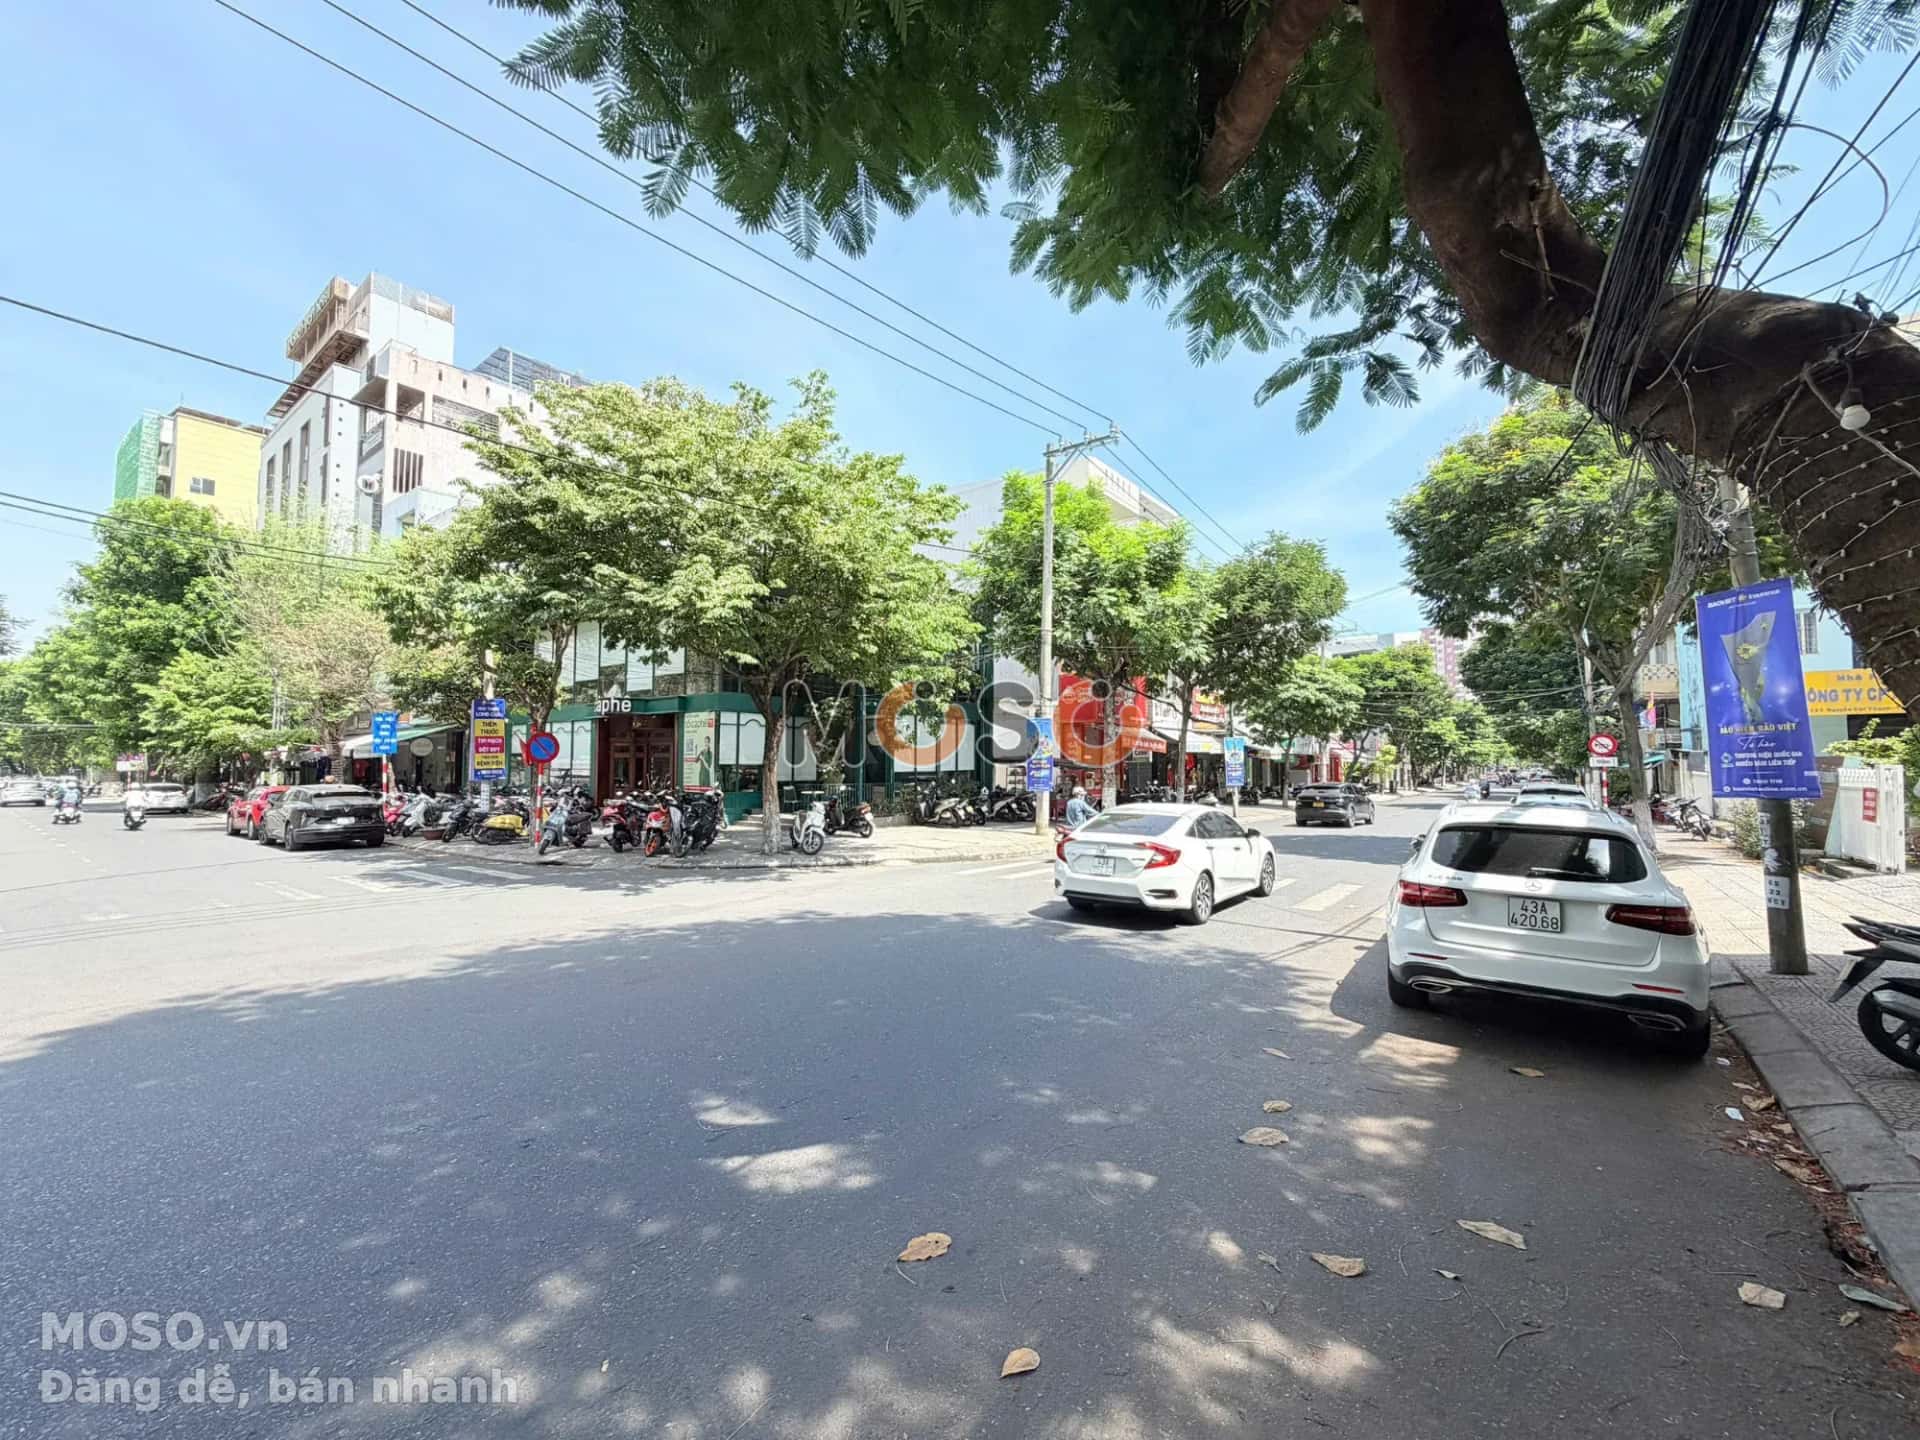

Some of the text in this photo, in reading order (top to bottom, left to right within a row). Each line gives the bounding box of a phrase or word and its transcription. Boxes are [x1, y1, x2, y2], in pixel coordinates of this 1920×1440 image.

[1843, 687, 1863, 702] TY
[1520, 900, 1548, 915] 43A
[1510, 913, 1560, 930] 420.68
